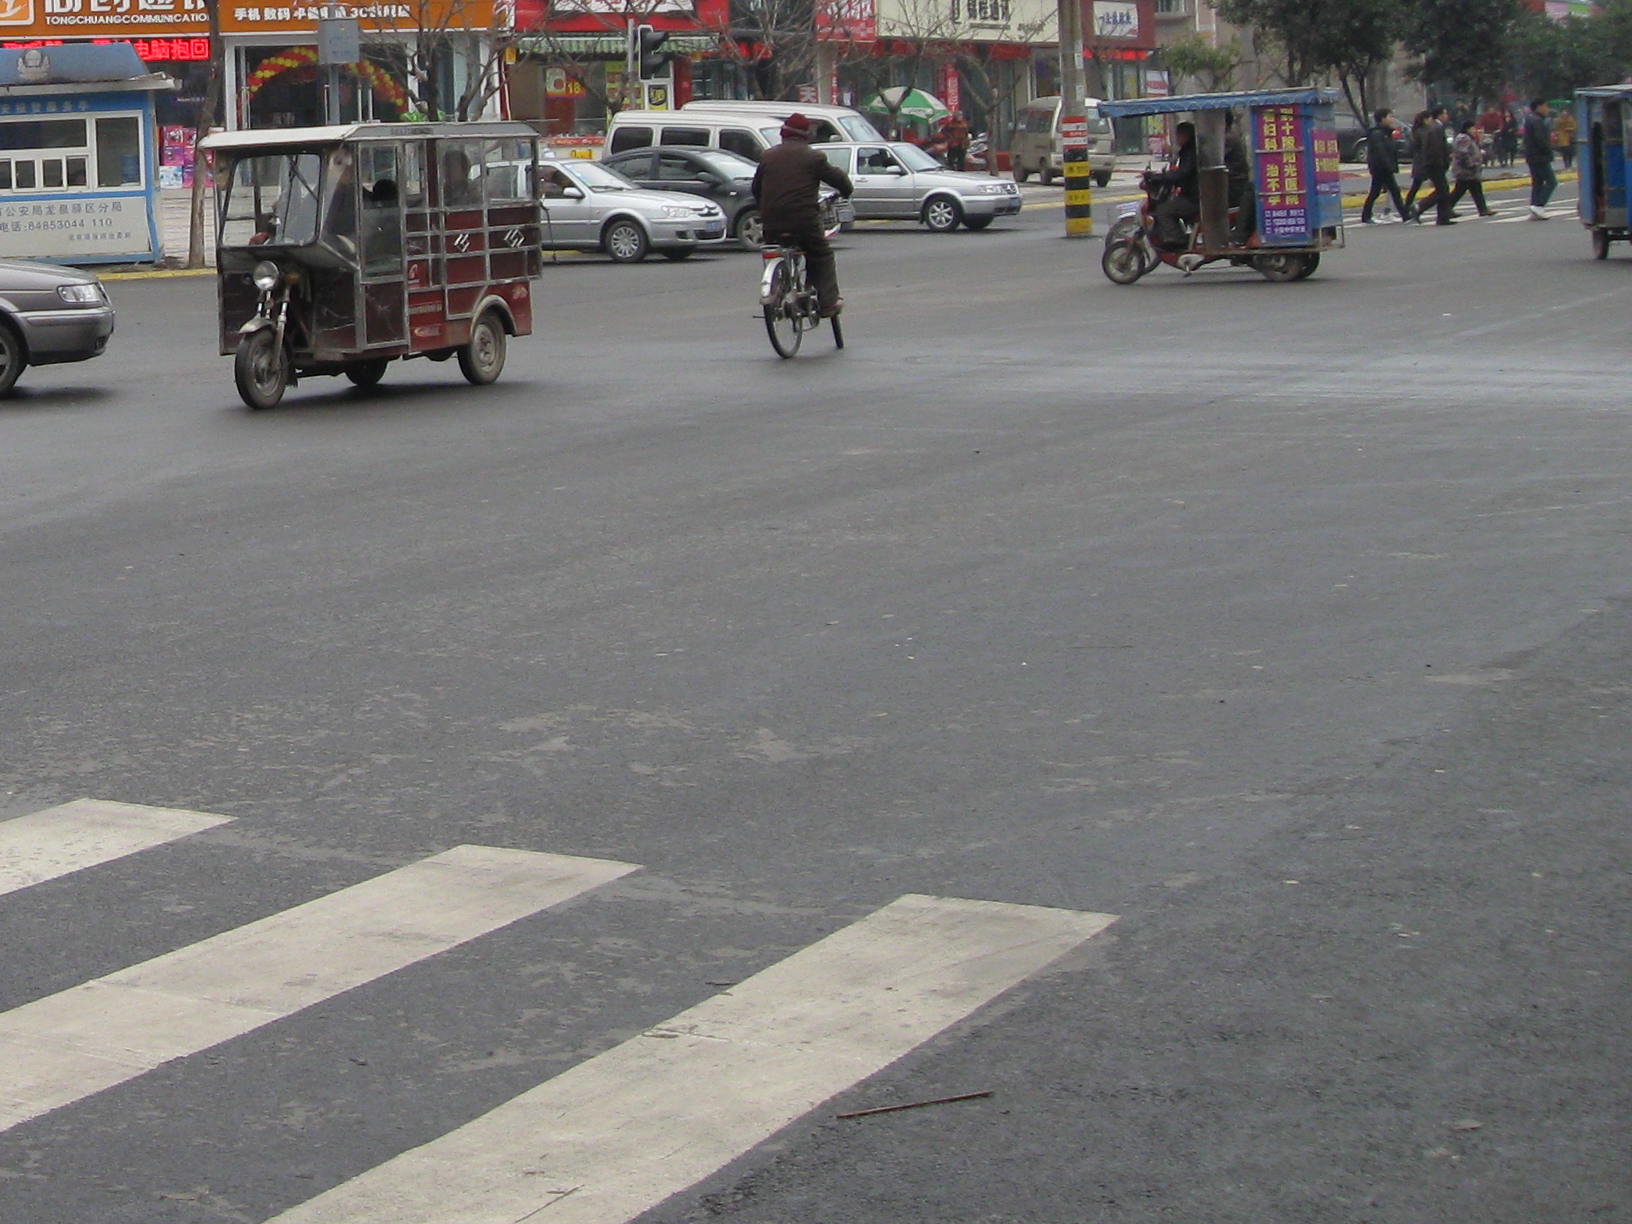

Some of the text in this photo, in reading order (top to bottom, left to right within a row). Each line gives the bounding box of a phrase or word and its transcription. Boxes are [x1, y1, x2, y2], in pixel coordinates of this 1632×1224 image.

[46, 13, 210, 25] TONGCHUANGCOMMUNICATIO
[234, 7, 261, 21] 手机
[264, 7, 290, 21] 数码
[92, 218, 112, 228] 110
